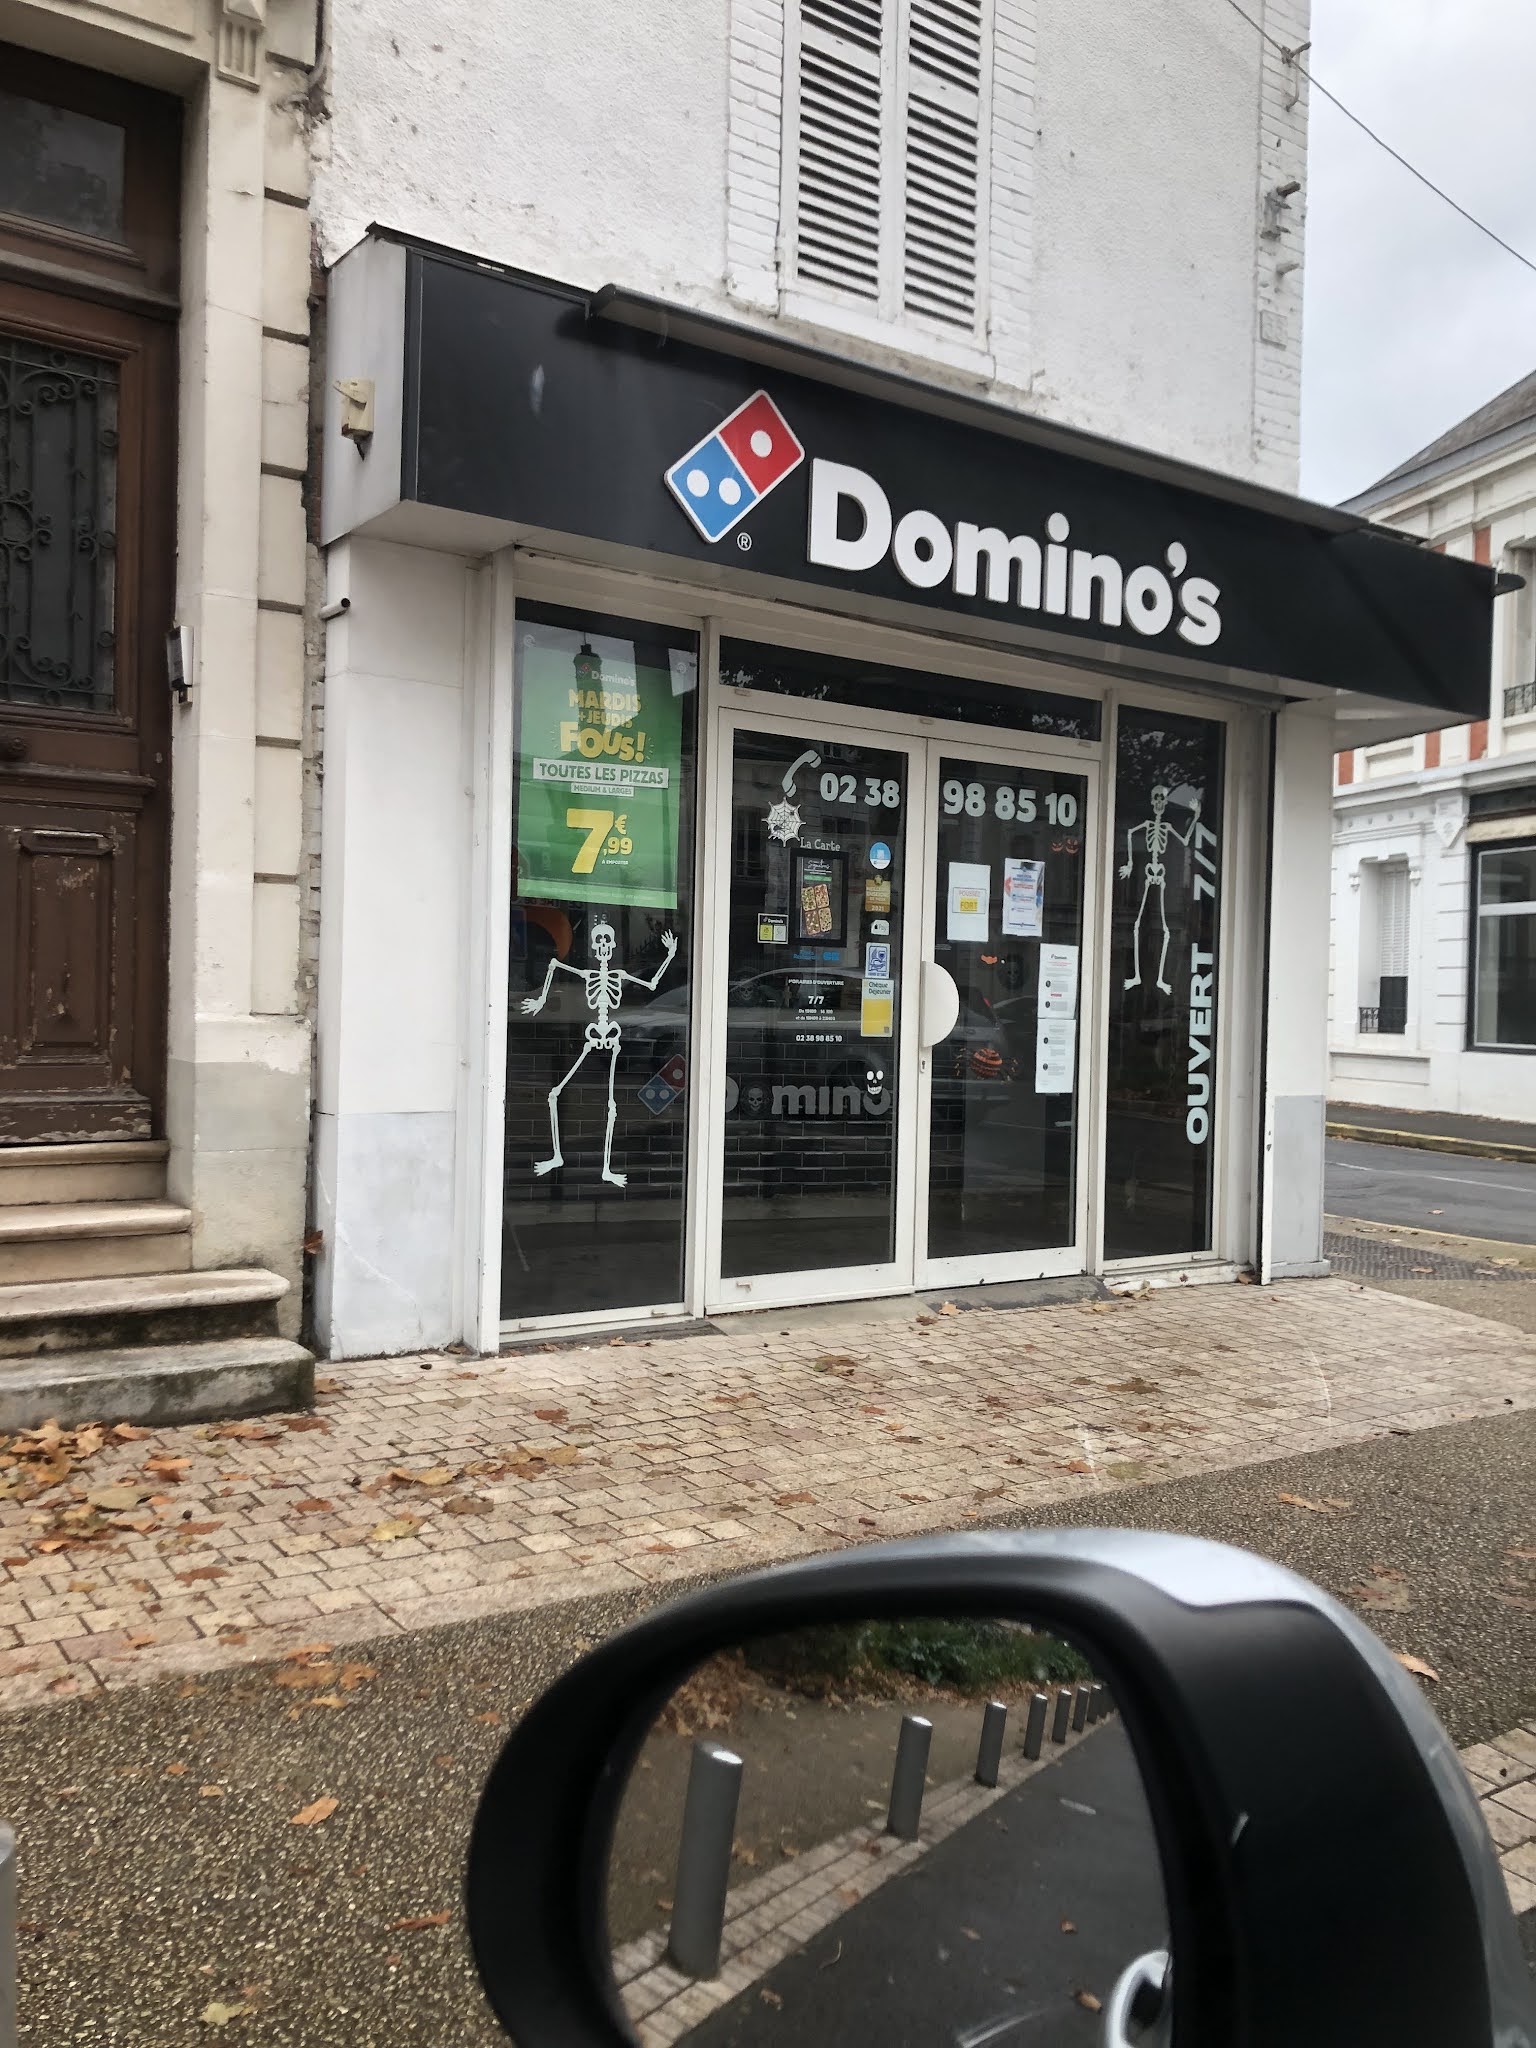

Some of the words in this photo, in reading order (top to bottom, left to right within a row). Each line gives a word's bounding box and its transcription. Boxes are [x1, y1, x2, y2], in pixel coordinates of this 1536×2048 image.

[807, 457, 1221, 646] Domino's
[591, 670, 636, 687] Domino's
[568, 688, 641, 713] MARDIS
[540, 763, 591, 781] TOUTES
[595, 767, 616, 781] LES
[620, 769, 664, 785] PIZZAS
[820, 772, 857, 804] 02
[864, 777, 900, 808] 38
[943, 780, 986, 817] 98
[994, 786, 1037, 823] 85
[1045, 792, 1077, 827] 10
[800, 836, 813, 850] La
[814, 838, 841, 852] Carte
[1193, 822, 1217, 900] 7/7
[960, 901, 977, 909] FORT
[808, 996, 825, 1004] 7/7
[796, 1034, 805, 1042] 02
[1185, 942, 1214, 1145] OUVERT
